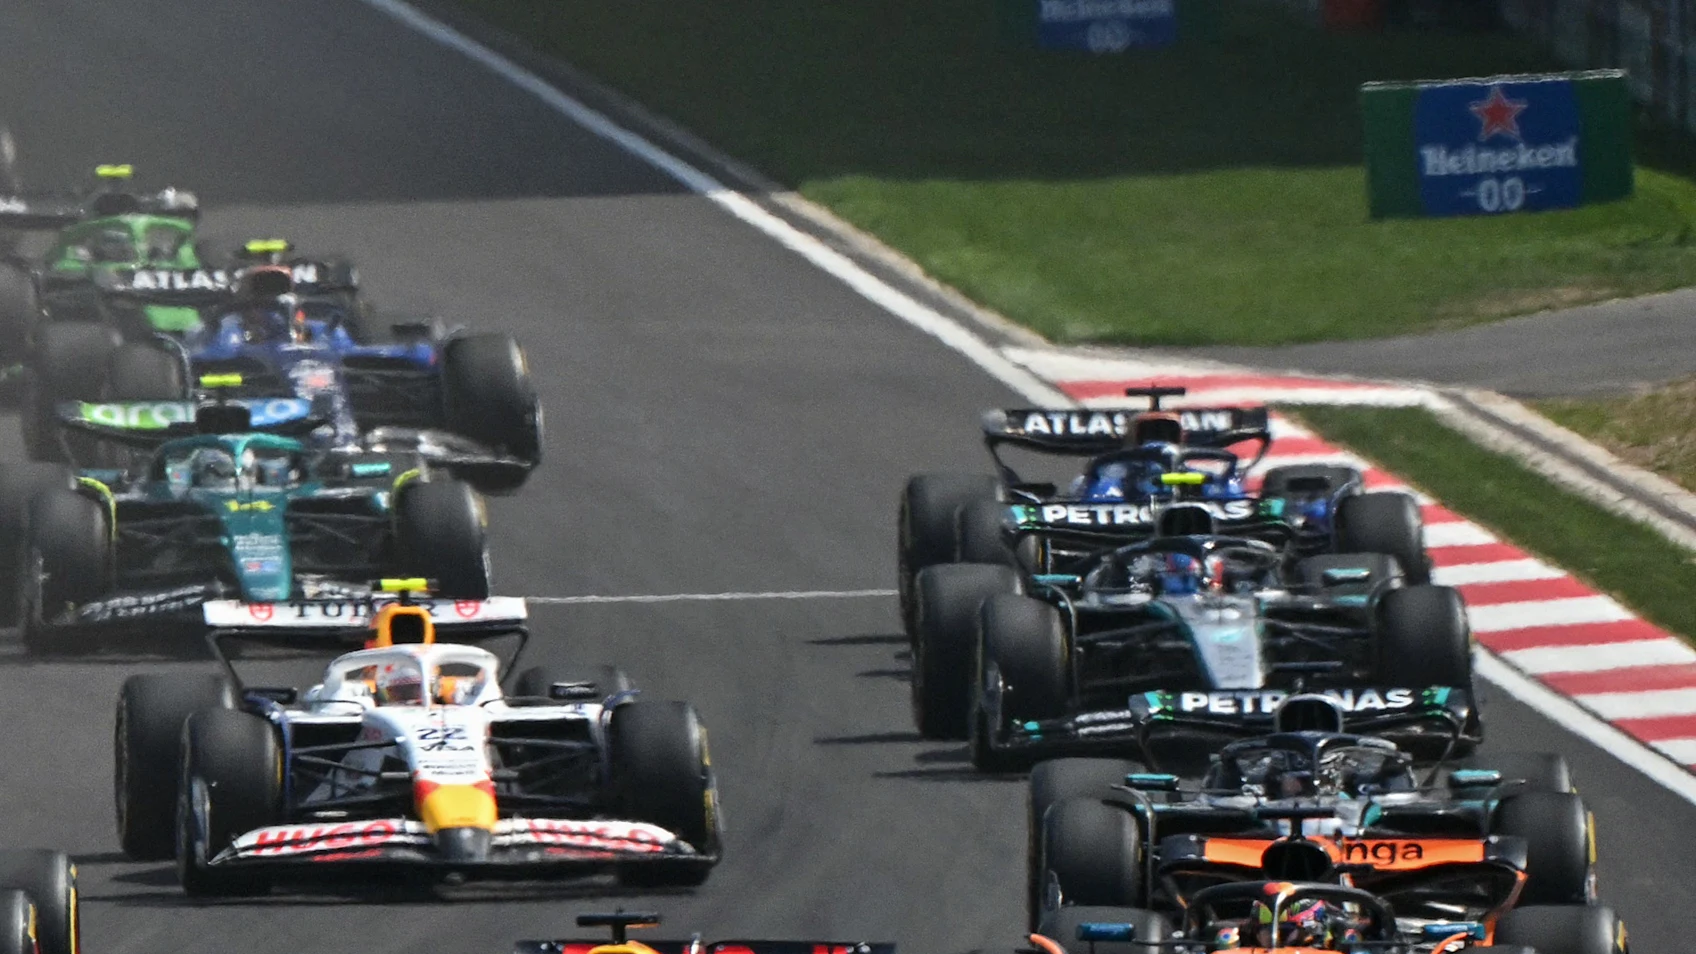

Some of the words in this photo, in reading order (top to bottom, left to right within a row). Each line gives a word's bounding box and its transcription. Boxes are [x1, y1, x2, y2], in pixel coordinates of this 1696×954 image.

[1420, 136, 1578, 175] Heineken
[1024, 411, 1233, 437] ATLASAN
[1181, 688, 1414, 714] PETRNAS
[416, 727, 467, 740] 22
[255, 820, 395, 855] HUGO
[1346, 842, 1423, 864] nga
